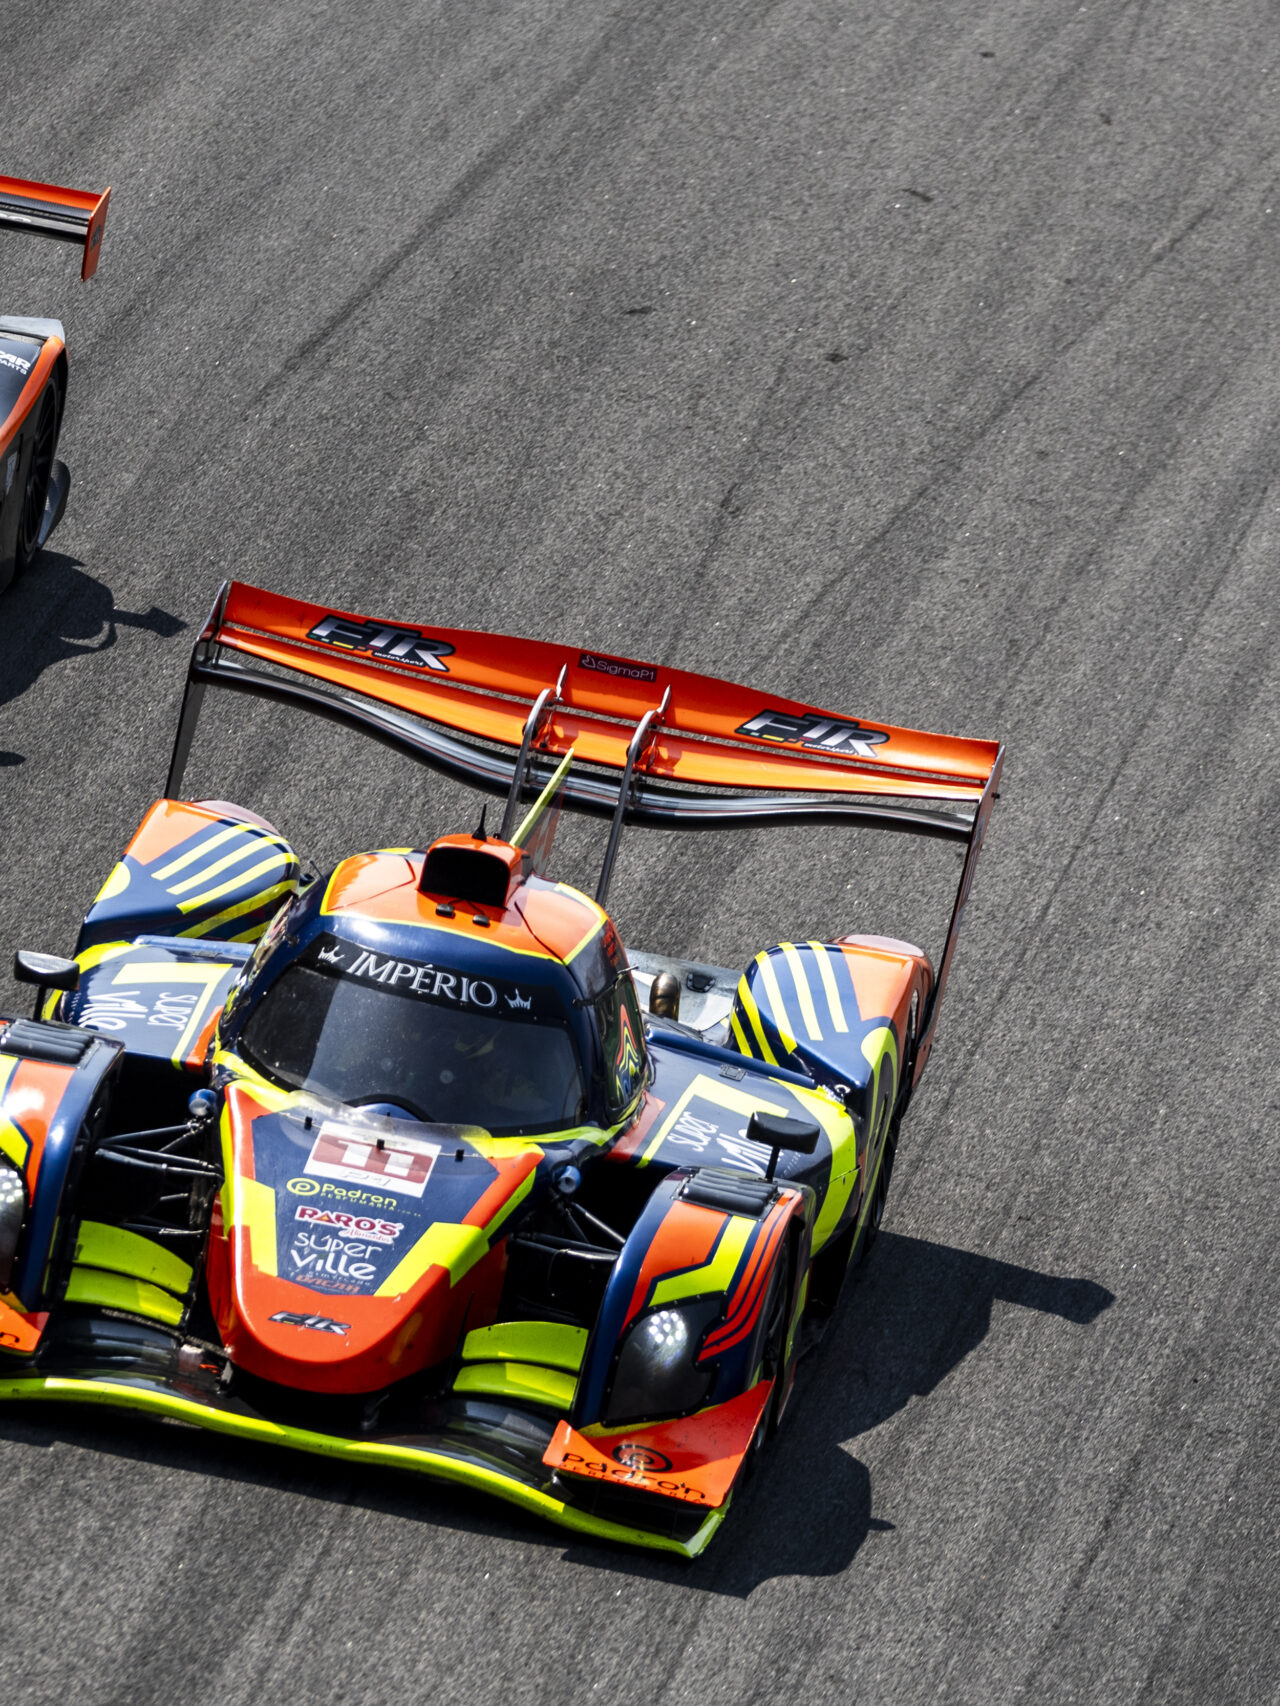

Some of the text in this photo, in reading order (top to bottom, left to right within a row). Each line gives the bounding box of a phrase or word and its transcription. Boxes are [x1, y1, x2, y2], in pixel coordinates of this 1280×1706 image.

[310, 615, 455, 671] FTR
[597, 660, 655, 680] SigmaP1
[742, 711, 890, 757] FTR
[346, 950, 497, 1008] IMPÉRIO
[322, 1183, 398, 1207] Padron
